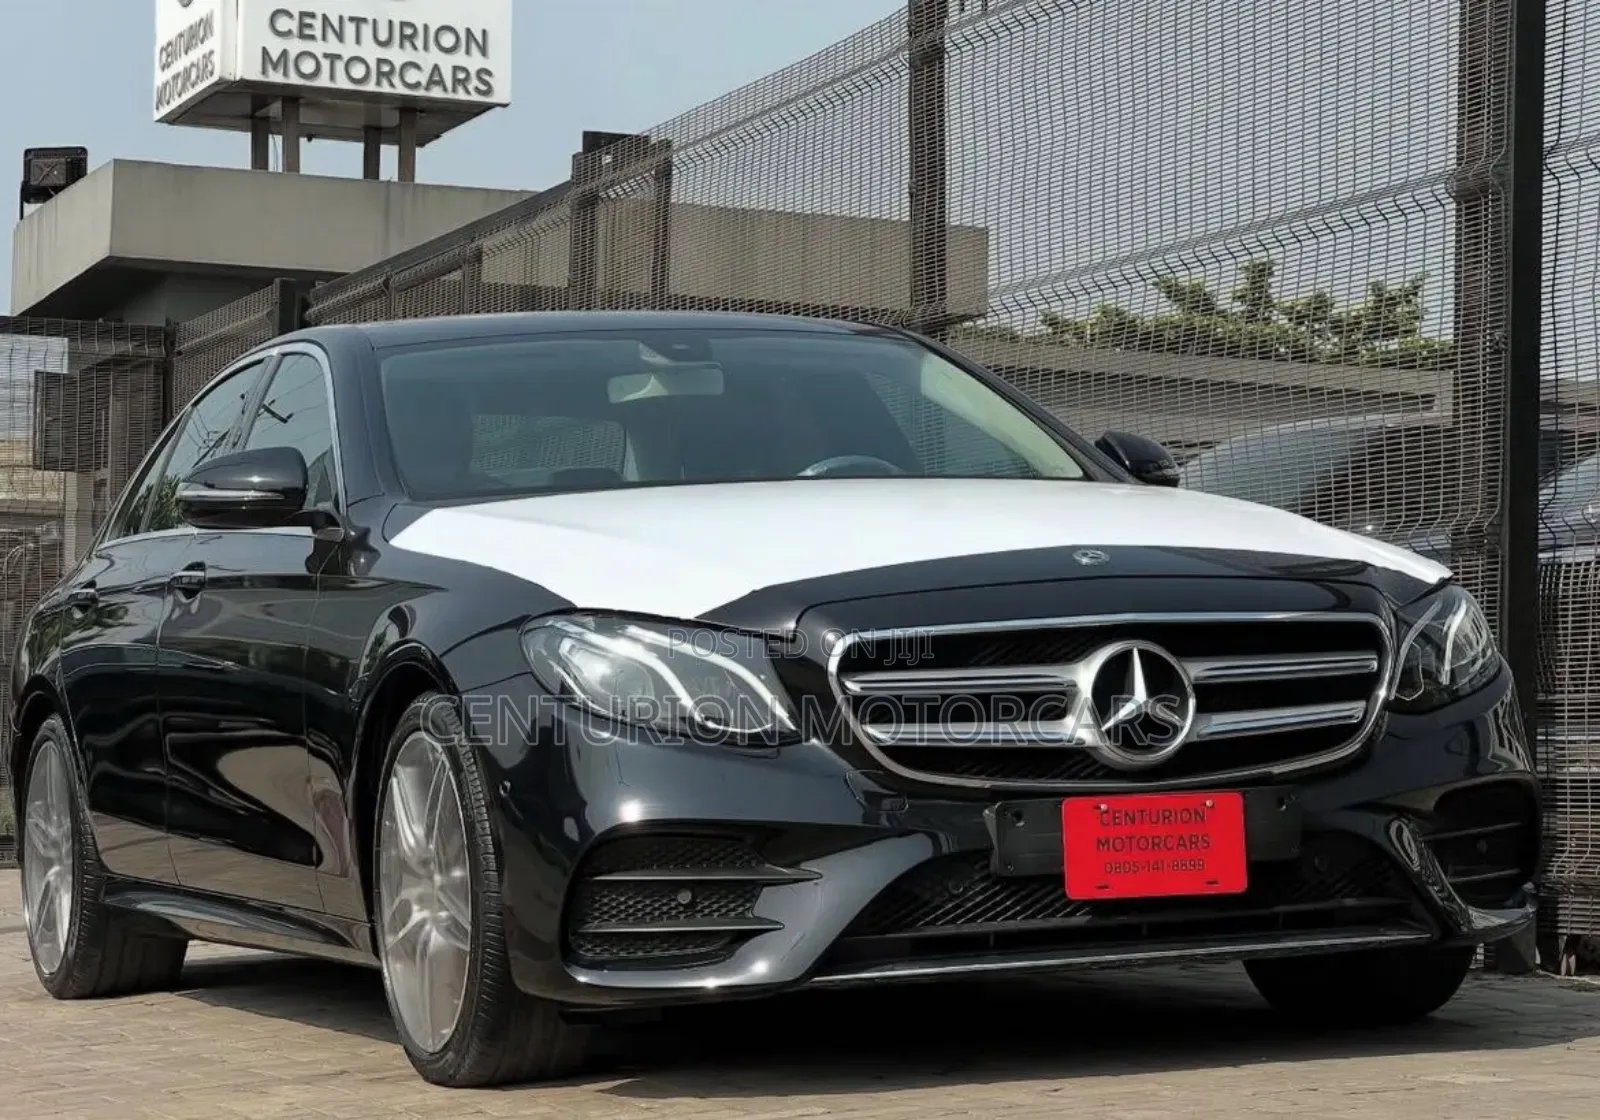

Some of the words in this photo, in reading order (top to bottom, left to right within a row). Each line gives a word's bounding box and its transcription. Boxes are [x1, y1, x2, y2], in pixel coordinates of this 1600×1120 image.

[159, 9, 214, 72] CENTURION
[269, 8, 489, 58] CENTURION
[261, 46, 495, 96] MOTORCARS
[1100, 808, 1205, 826] CENTURION
[1096, 834, 1211, 853] MOTORCARS
